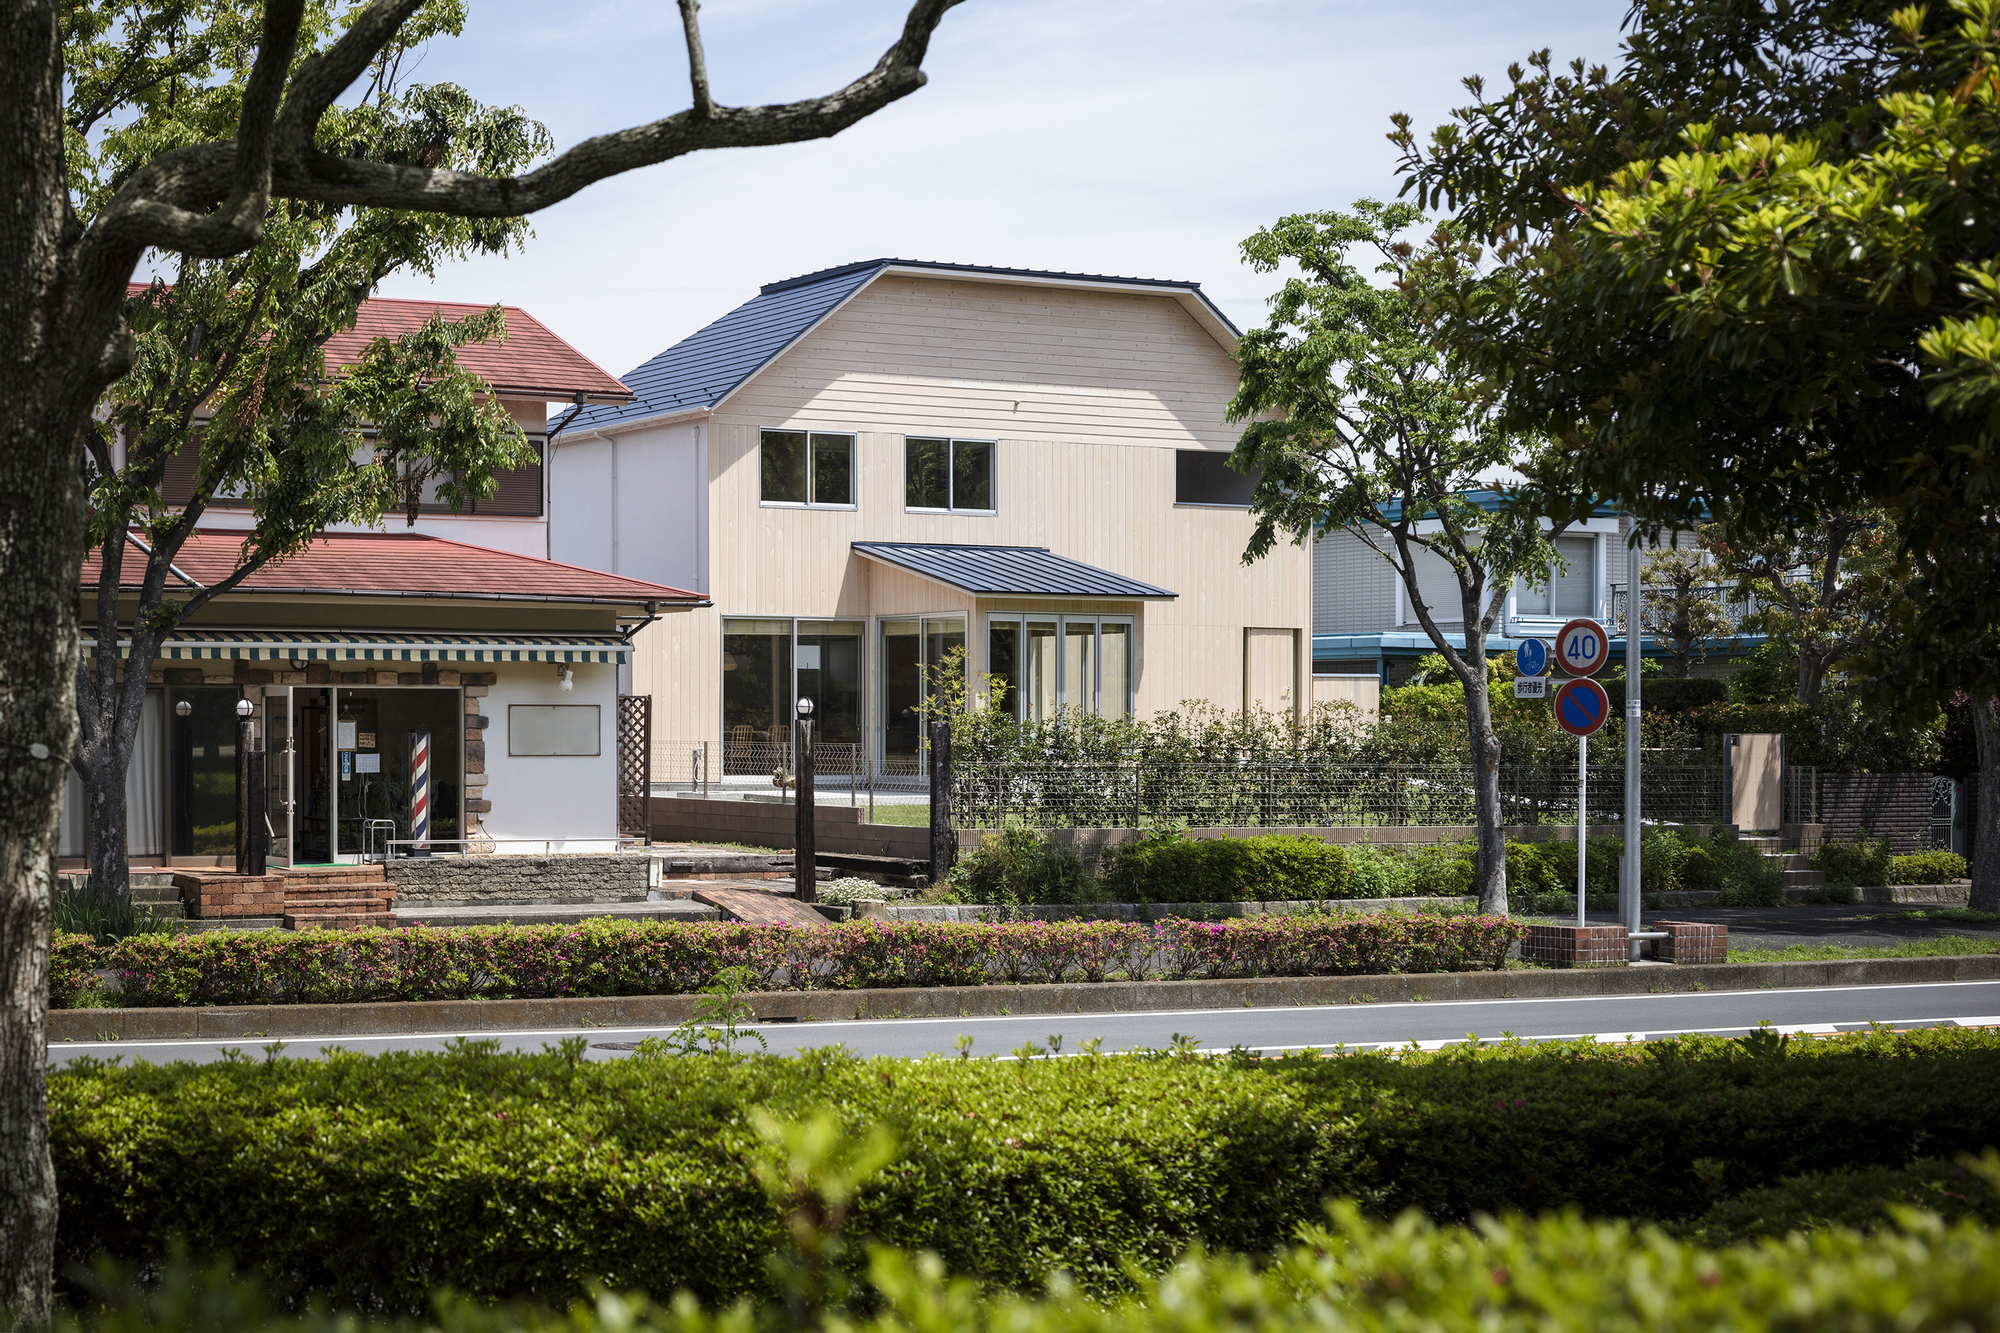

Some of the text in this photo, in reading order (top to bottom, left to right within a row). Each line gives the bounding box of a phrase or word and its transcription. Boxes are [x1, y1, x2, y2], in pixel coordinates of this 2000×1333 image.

[1567, 635, 1596, 660] 40
[1517, 681, 1543, 694] 歩行者優先
